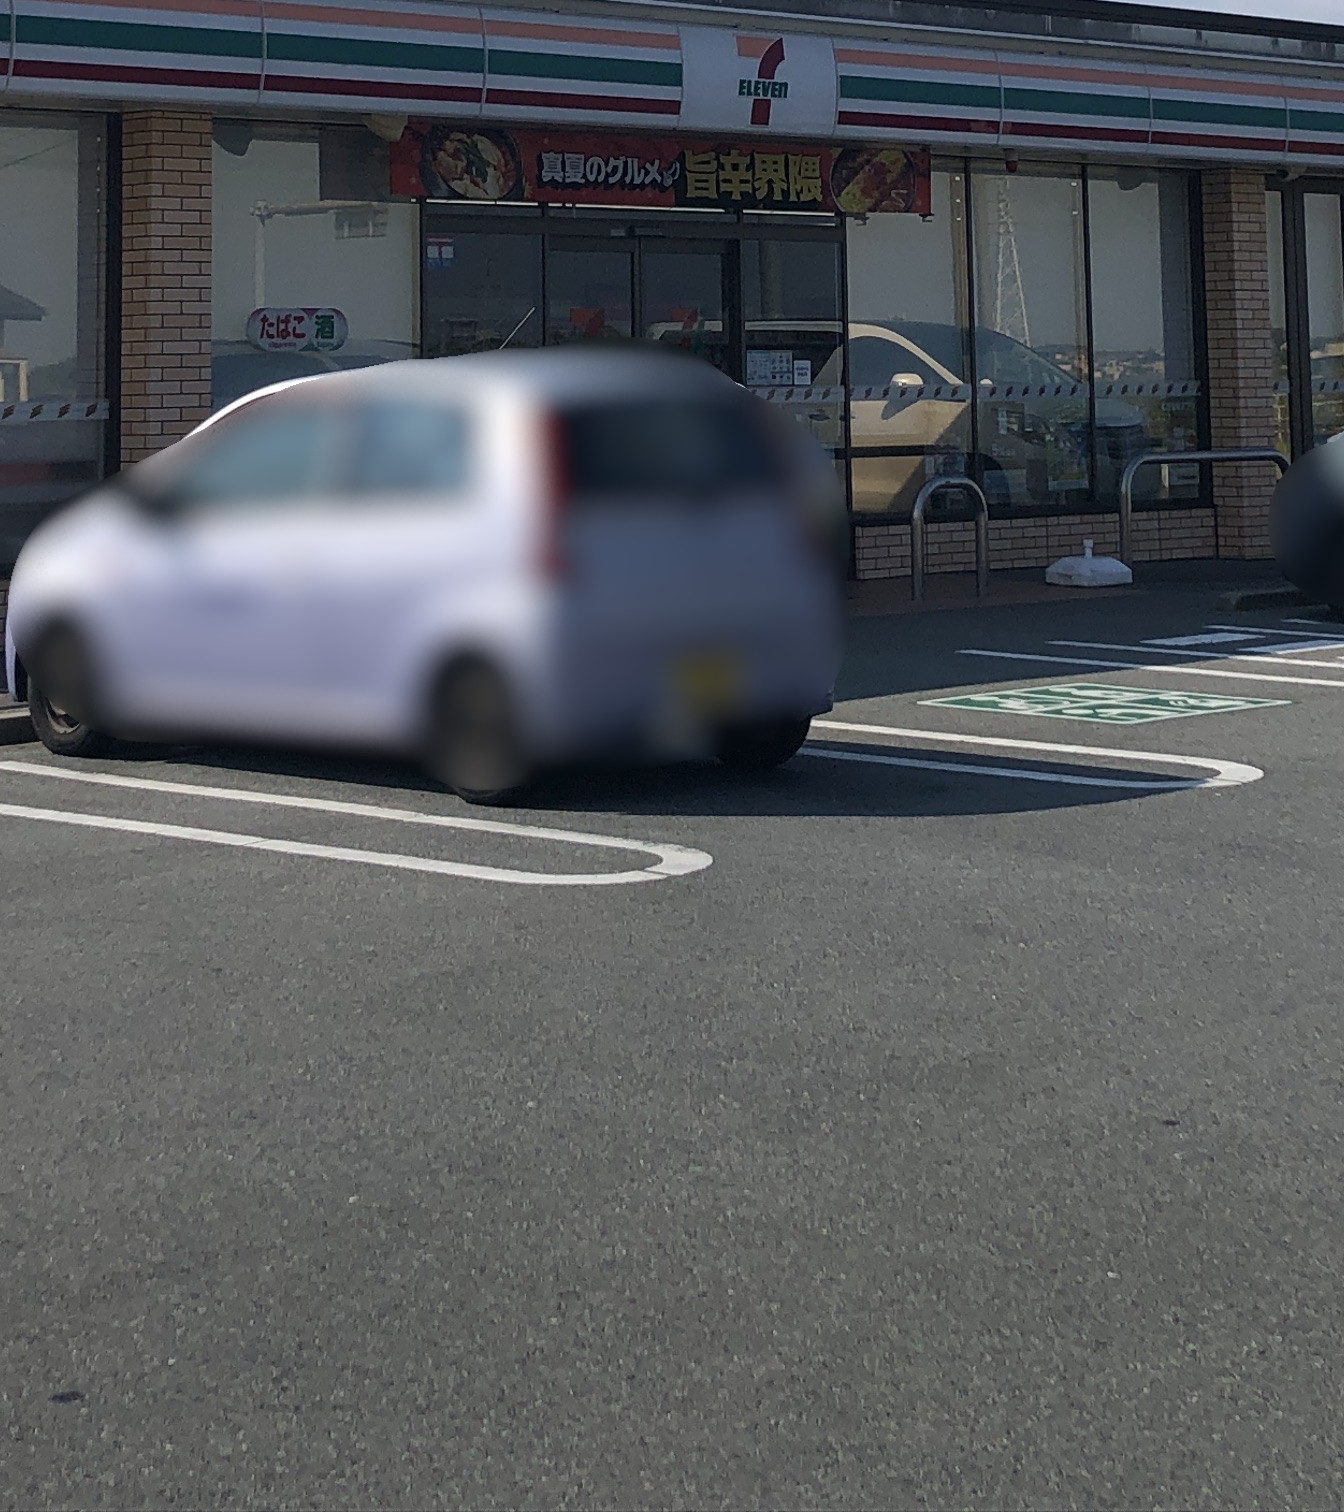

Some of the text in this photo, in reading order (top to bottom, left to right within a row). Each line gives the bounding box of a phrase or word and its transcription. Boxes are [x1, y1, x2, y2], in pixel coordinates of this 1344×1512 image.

[685, 149, 824, 204] 旨辛界隈
[260, 313, 335, 339] たばこ 酒
